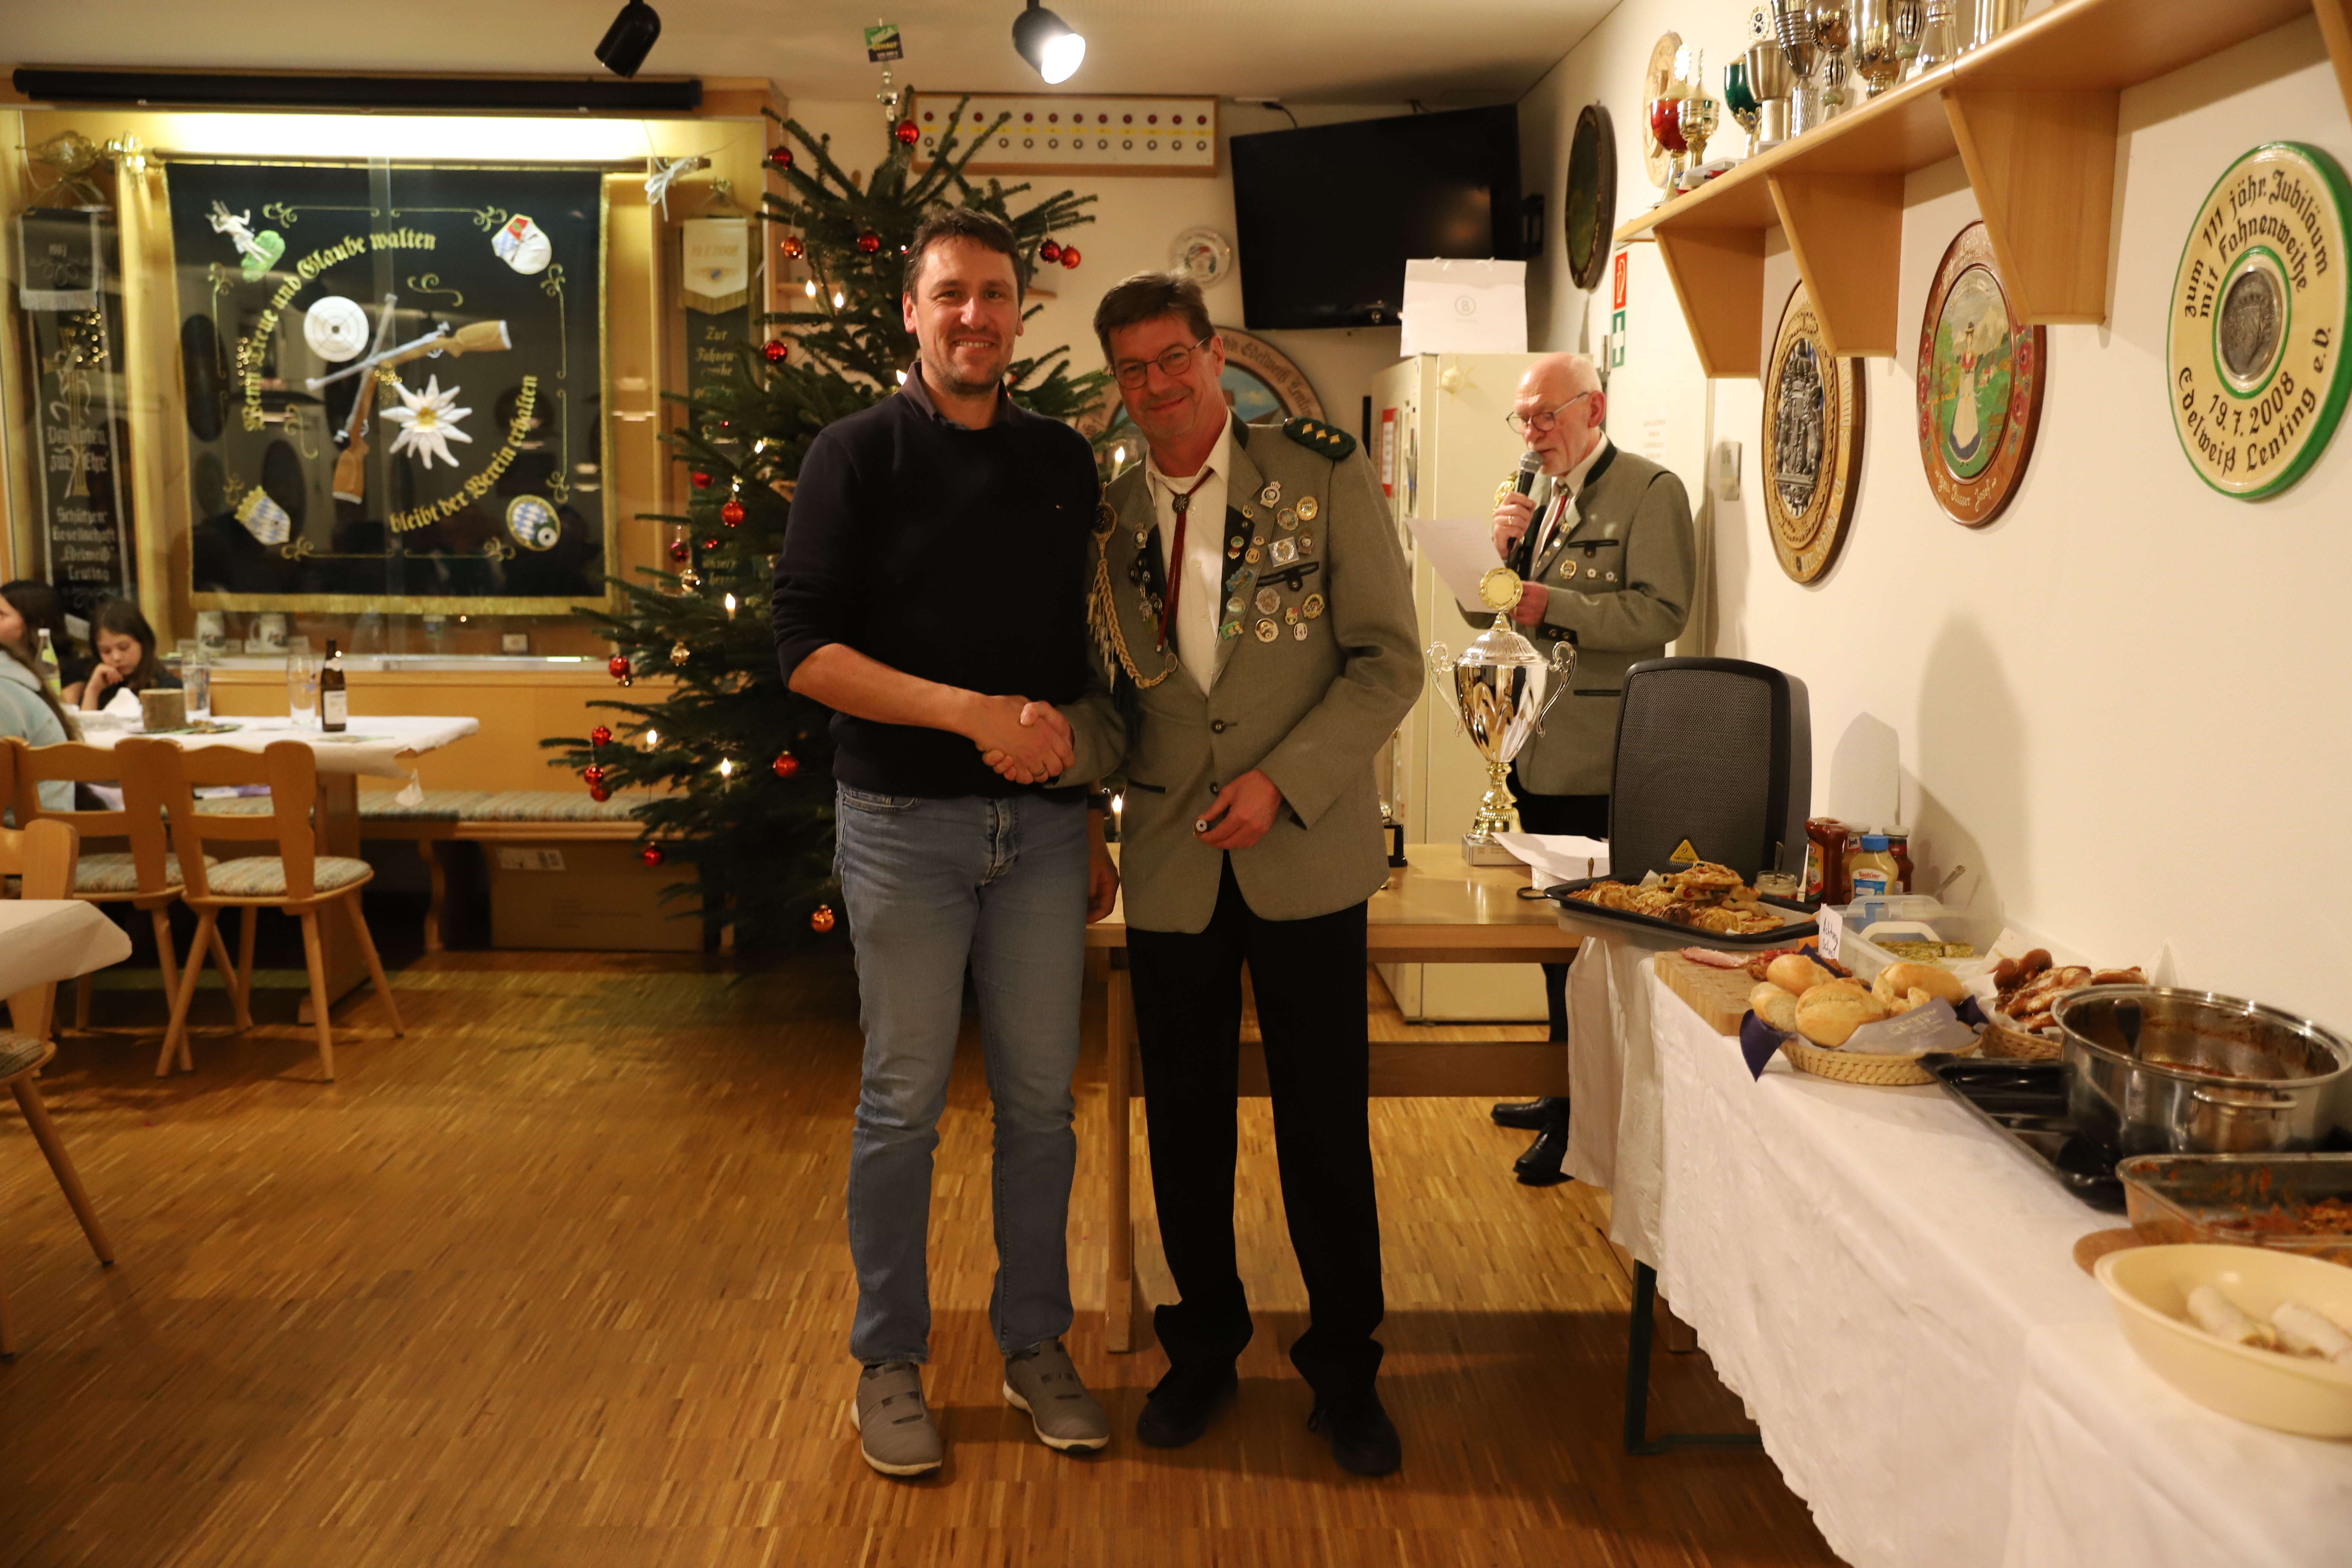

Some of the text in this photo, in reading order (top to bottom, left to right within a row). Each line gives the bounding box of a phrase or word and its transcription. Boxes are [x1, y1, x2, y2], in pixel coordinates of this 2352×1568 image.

[2199, 215, 2308, 318] mit Fahnenweihe
[2269, 169, 2329, 277] Jubiläum
[246, 309, 278, 367] Treue
[273, 276, 302, 310] und
[296, 234, 365, 280] Glaube
[371, 227, 437, 251] walten
[705, 325, 728, 341] Zur
[1287, 378, 1312, 416] Lentin
[2179, 367, 2236, 476] Edelweiß
[2246, 387, 2315, 472] Lenting
[390, 375, 537, 534] bleibt der Verein erhalten
